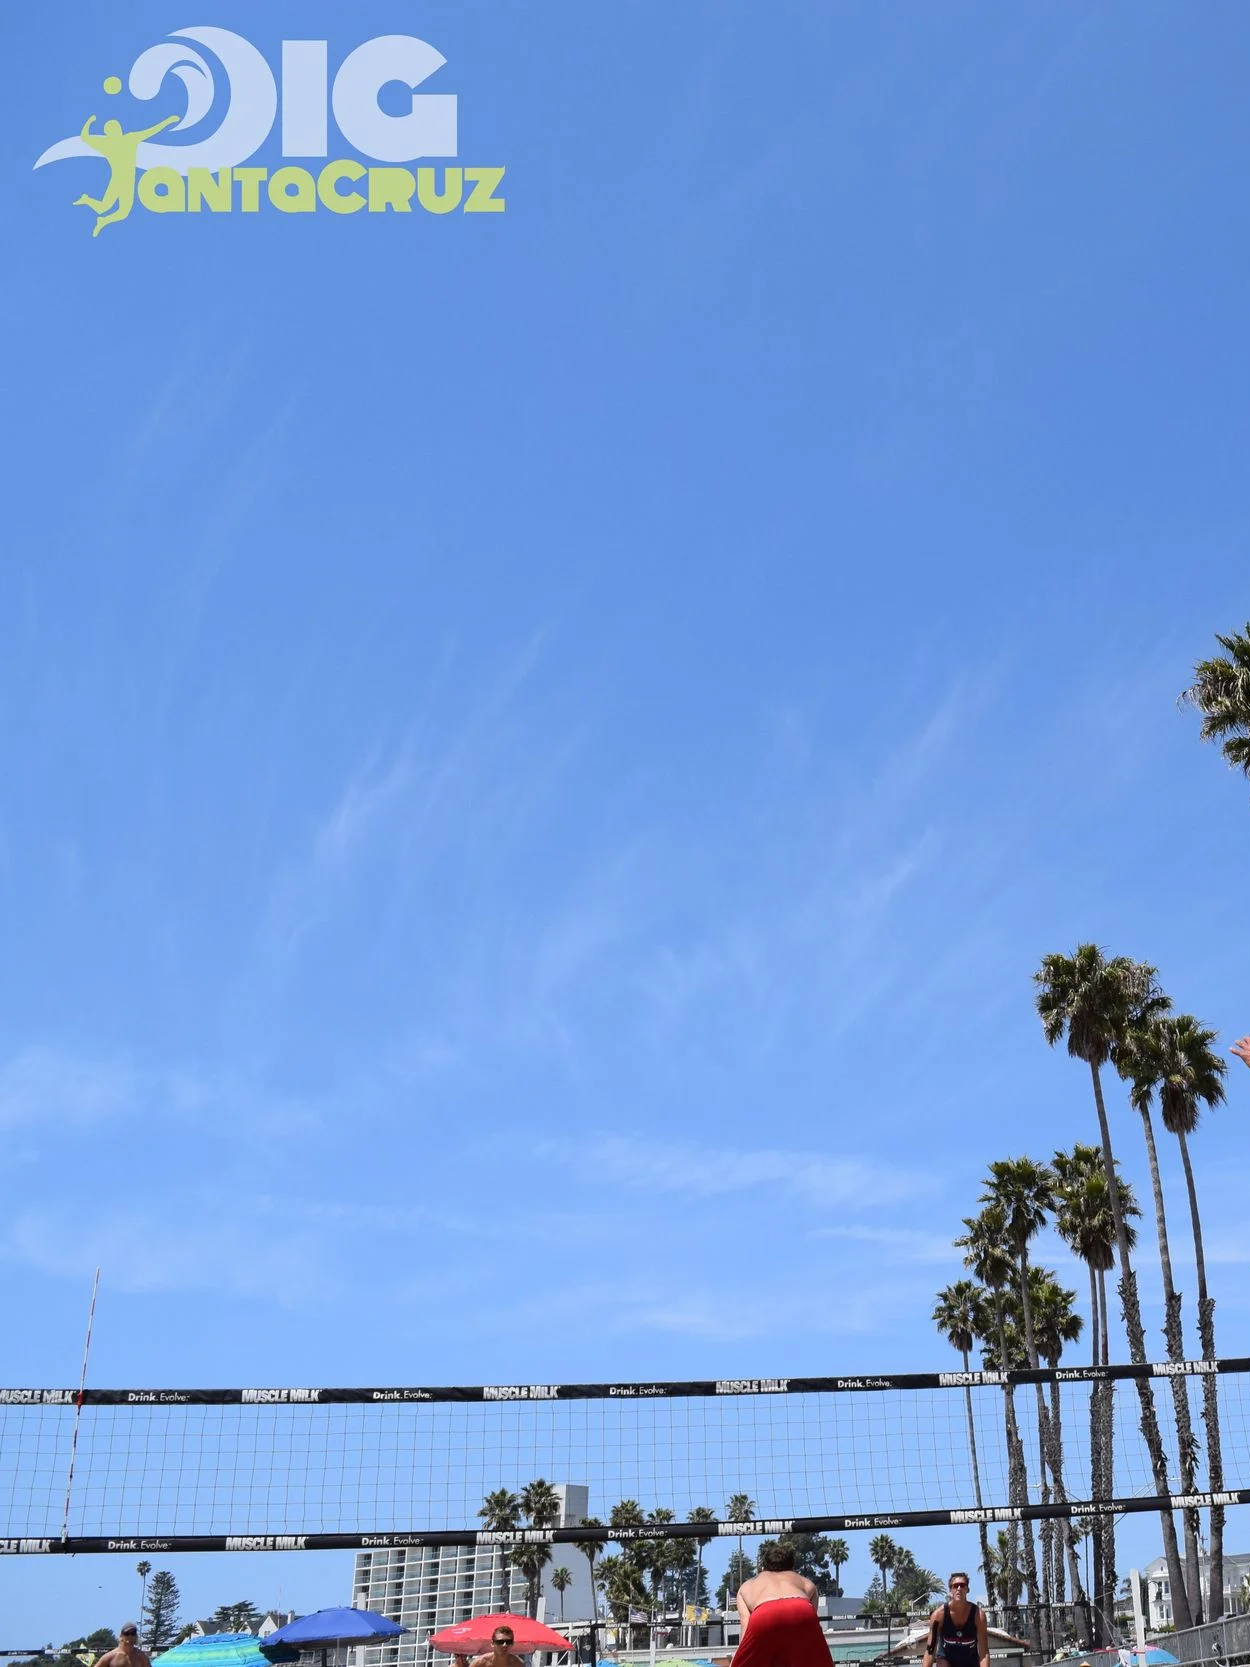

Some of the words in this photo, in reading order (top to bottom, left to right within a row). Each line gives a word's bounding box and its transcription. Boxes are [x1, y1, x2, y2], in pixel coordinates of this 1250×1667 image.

[1152, 1362, 1191, 1375] MUSCLE
[1194, 1360, 1218, 1373] MILK
[939, 1372, 980, 1385] MUSCLE
[982, 1371, 1008, 1383] MILK
[483, 1386, 528, 1398] MUSCLE
[530, 1385, 557, 1397] MILK
[715, 1380, 758, 1392] MUSCLE
[760, 1379, 787, 1391] MILK
[43, 1389, 72, 1403] MILK
[241, 1389, 287, 1402] MUSCLE
[290, 1389, 319, 1401] MILK
[1171, 1494, 1211, 1508] MUSCLE
[1213, 1492, 1239, 1505] MILK
[950, 1509, 992, 1523] MUSCLE
[994, 1508, 1021, 1520] MILK
[718, 1522, 762, 1535] MUSCLE
[765, 1521, 793, 1533] MILK
[225, 1536, 273, 1550] MUSCLE
[276, 1536, 306, 1549] MILK
[476, 1531, 522, 1544] MUSCLE
[525, 1530, 553, 1542] MILK
[20, 1539, 50, 1552] MILK
